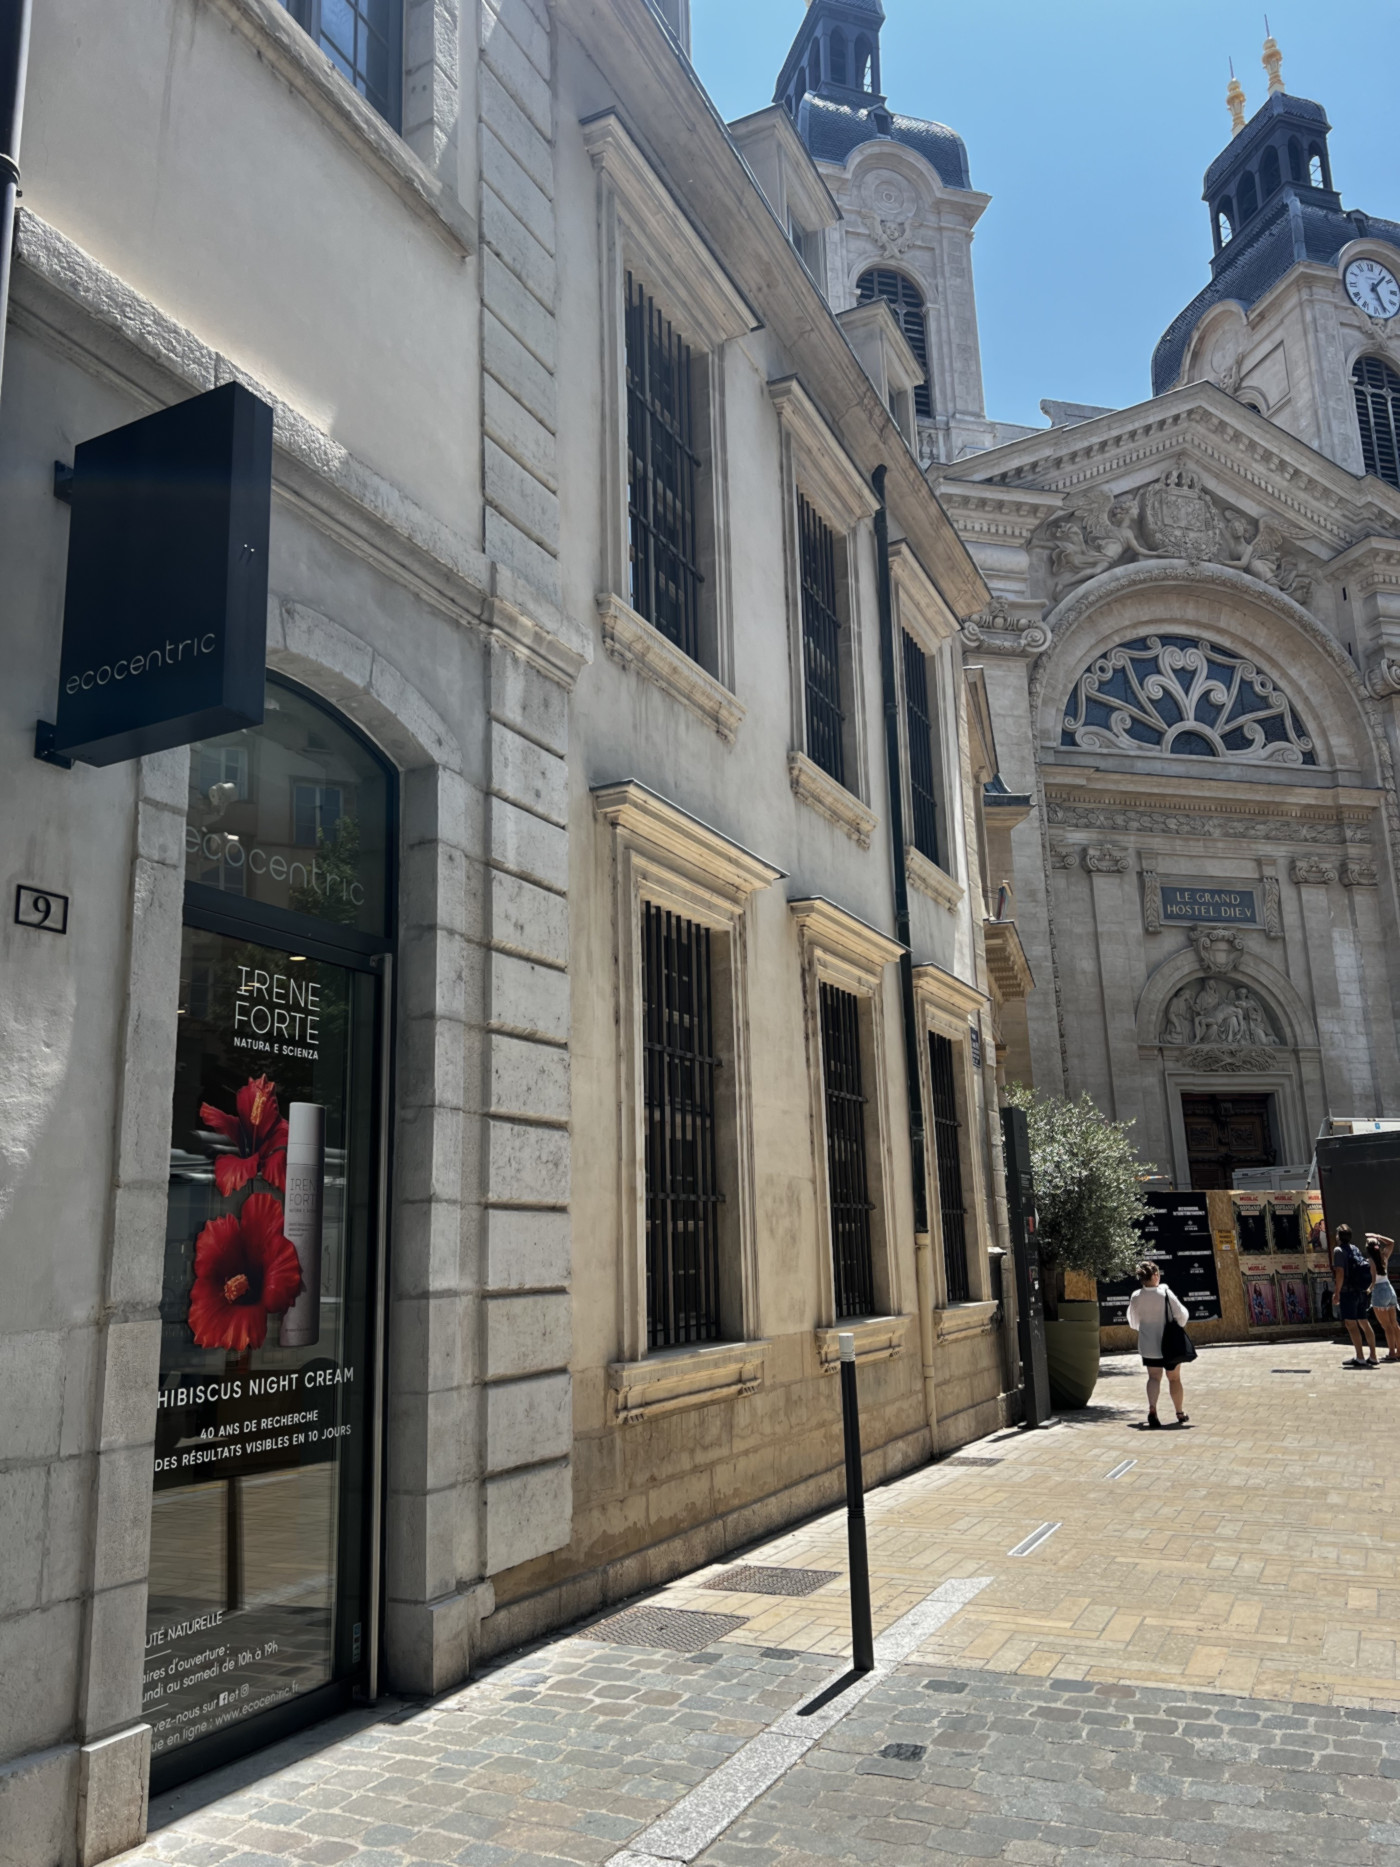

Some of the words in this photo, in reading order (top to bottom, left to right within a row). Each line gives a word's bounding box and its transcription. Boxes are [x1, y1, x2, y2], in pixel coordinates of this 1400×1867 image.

[66, 633, 215, 694] ecocentric
[186, 826, 365, 905] ecocentric
[33, 895, 51, 926] 9
[1167, 904, 1218, 917] HOSTEL
[1221, 906, 1252, 918] DIEV
[1176, 891, 1193, 902] LE
[1196, 892, 1240, 904] GRAND
[237, 965, 321, 1011] IRENE
[234, 1001, 320, 1044] FORTE
[233, 1036, 270, 1052] NATURA
[274, 1043, 279, 1053] E
[282, 1045, 319, 1060] SCIENZA
[157, 1381, 242, 1408] HIBISCUS
[249, 1374, 299, 1397] NIGHT
[304, 1367, 354, 1388] CREAM
[200, 1426, 215, 1440] 40
[218, 1423, 240, 1436] ANS
[244, 1419, 257, 1433] DE
[261, 1410, 319, 1430] RECHERCHE
[155, 1455, 178, 1471] DES
[182, 1444, 242, 1466] RÉSULTATS
[246, 1435, 289, 1454] VISIBLES
[292, 1432, 305, 1445] EN
[308, 1430, 318, 1442] 10
[321, 1424, 351, 1440] JOURS
[168, 1610, 223, 1641] NATURELLE
[166, 1680, 180, 1693] au
[183, 1661, 219, 1688] samedi
[222, 1657, 235, 1673] de
[238, 1651, 253, 1667] 10h
[255, 1648, 261, 1660] à
[264, 1640, 278, 1655] 19h
[168, 1646, 225, 1675] d'ouverture
[167, 1732, 180, 1746] en
[183, 1721, 207, 1742] ligne
[215, 1679, 300, 1725] www.ecocentric.fr
[202, 1699, 218, 1714] sur
[230, 1690, 239, 1703] et
